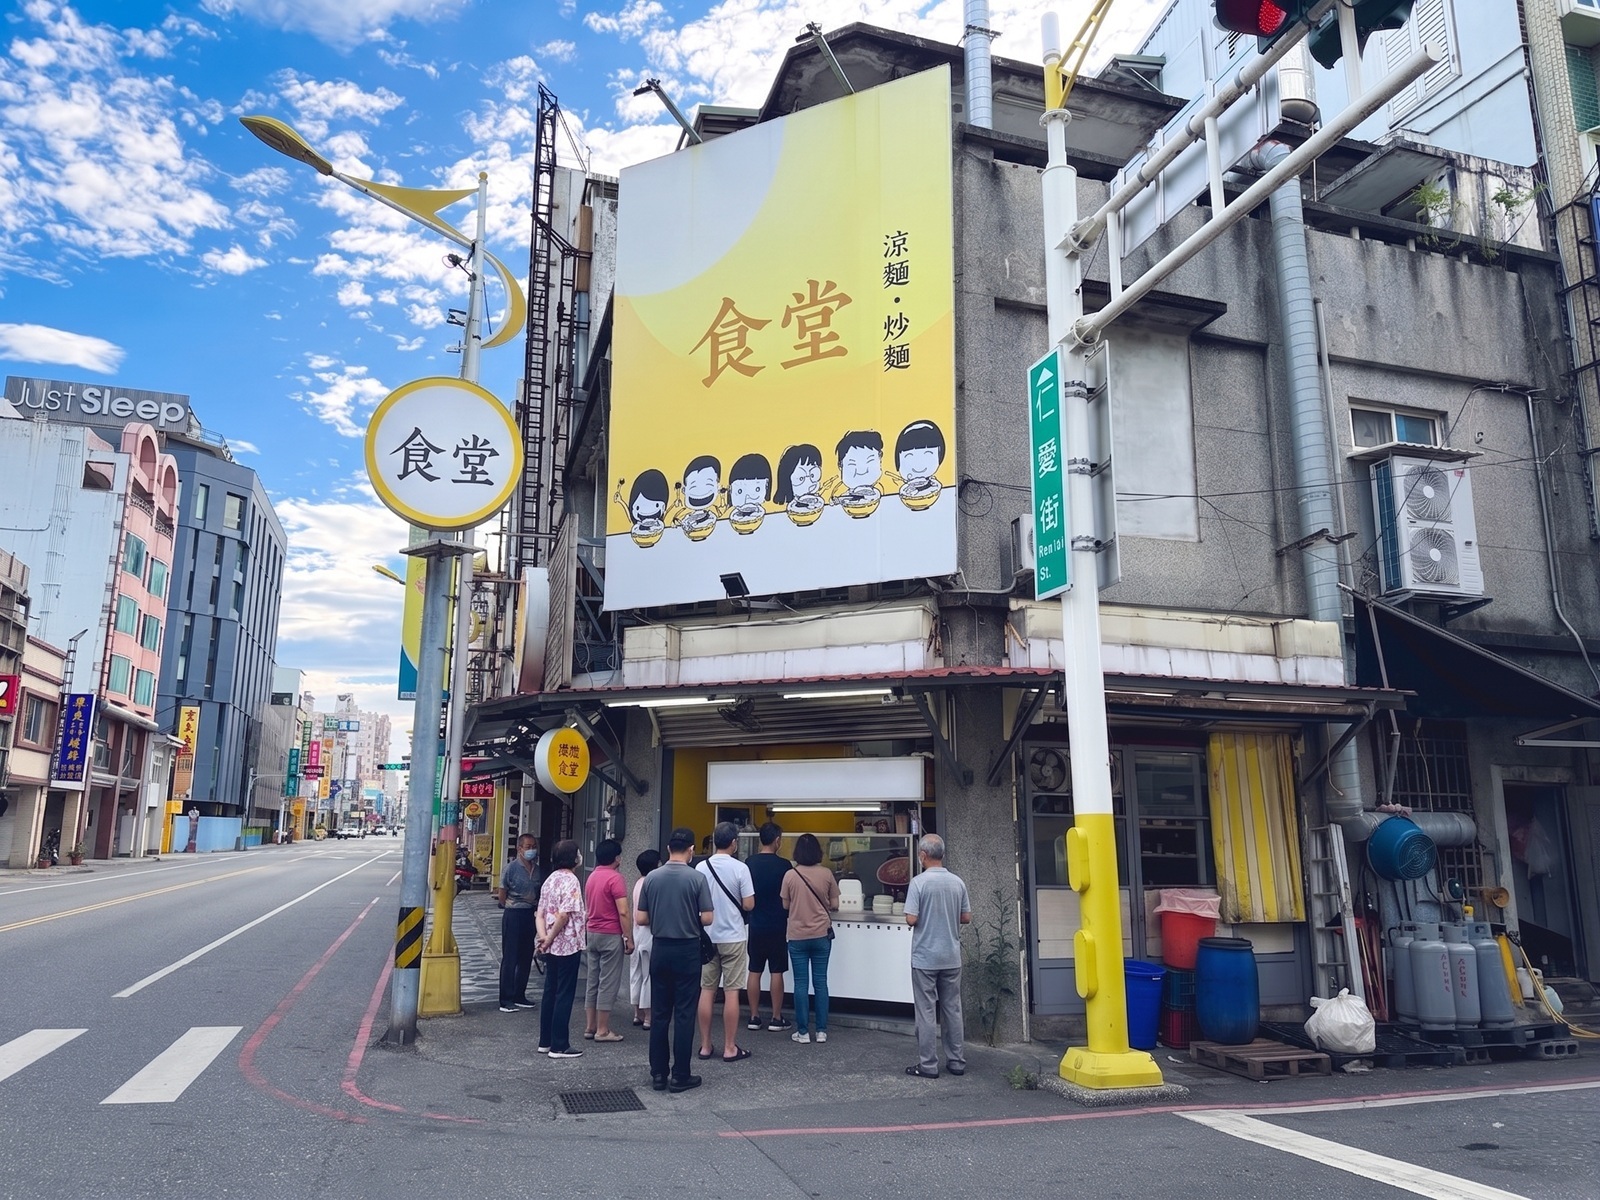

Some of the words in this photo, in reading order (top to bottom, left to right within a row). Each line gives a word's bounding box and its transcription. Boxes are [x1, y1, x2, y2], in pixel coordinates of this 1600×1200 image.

[688, 279, 853, 389] 食堂
[11, 380, 77, 413] Just
[80, 387, 186, 427] Sleep
[388, 426, 500, 486] 食堂
[1036, 382, 1060, 534] 仁愛街
[1040, 566, 1052, 581] St.
